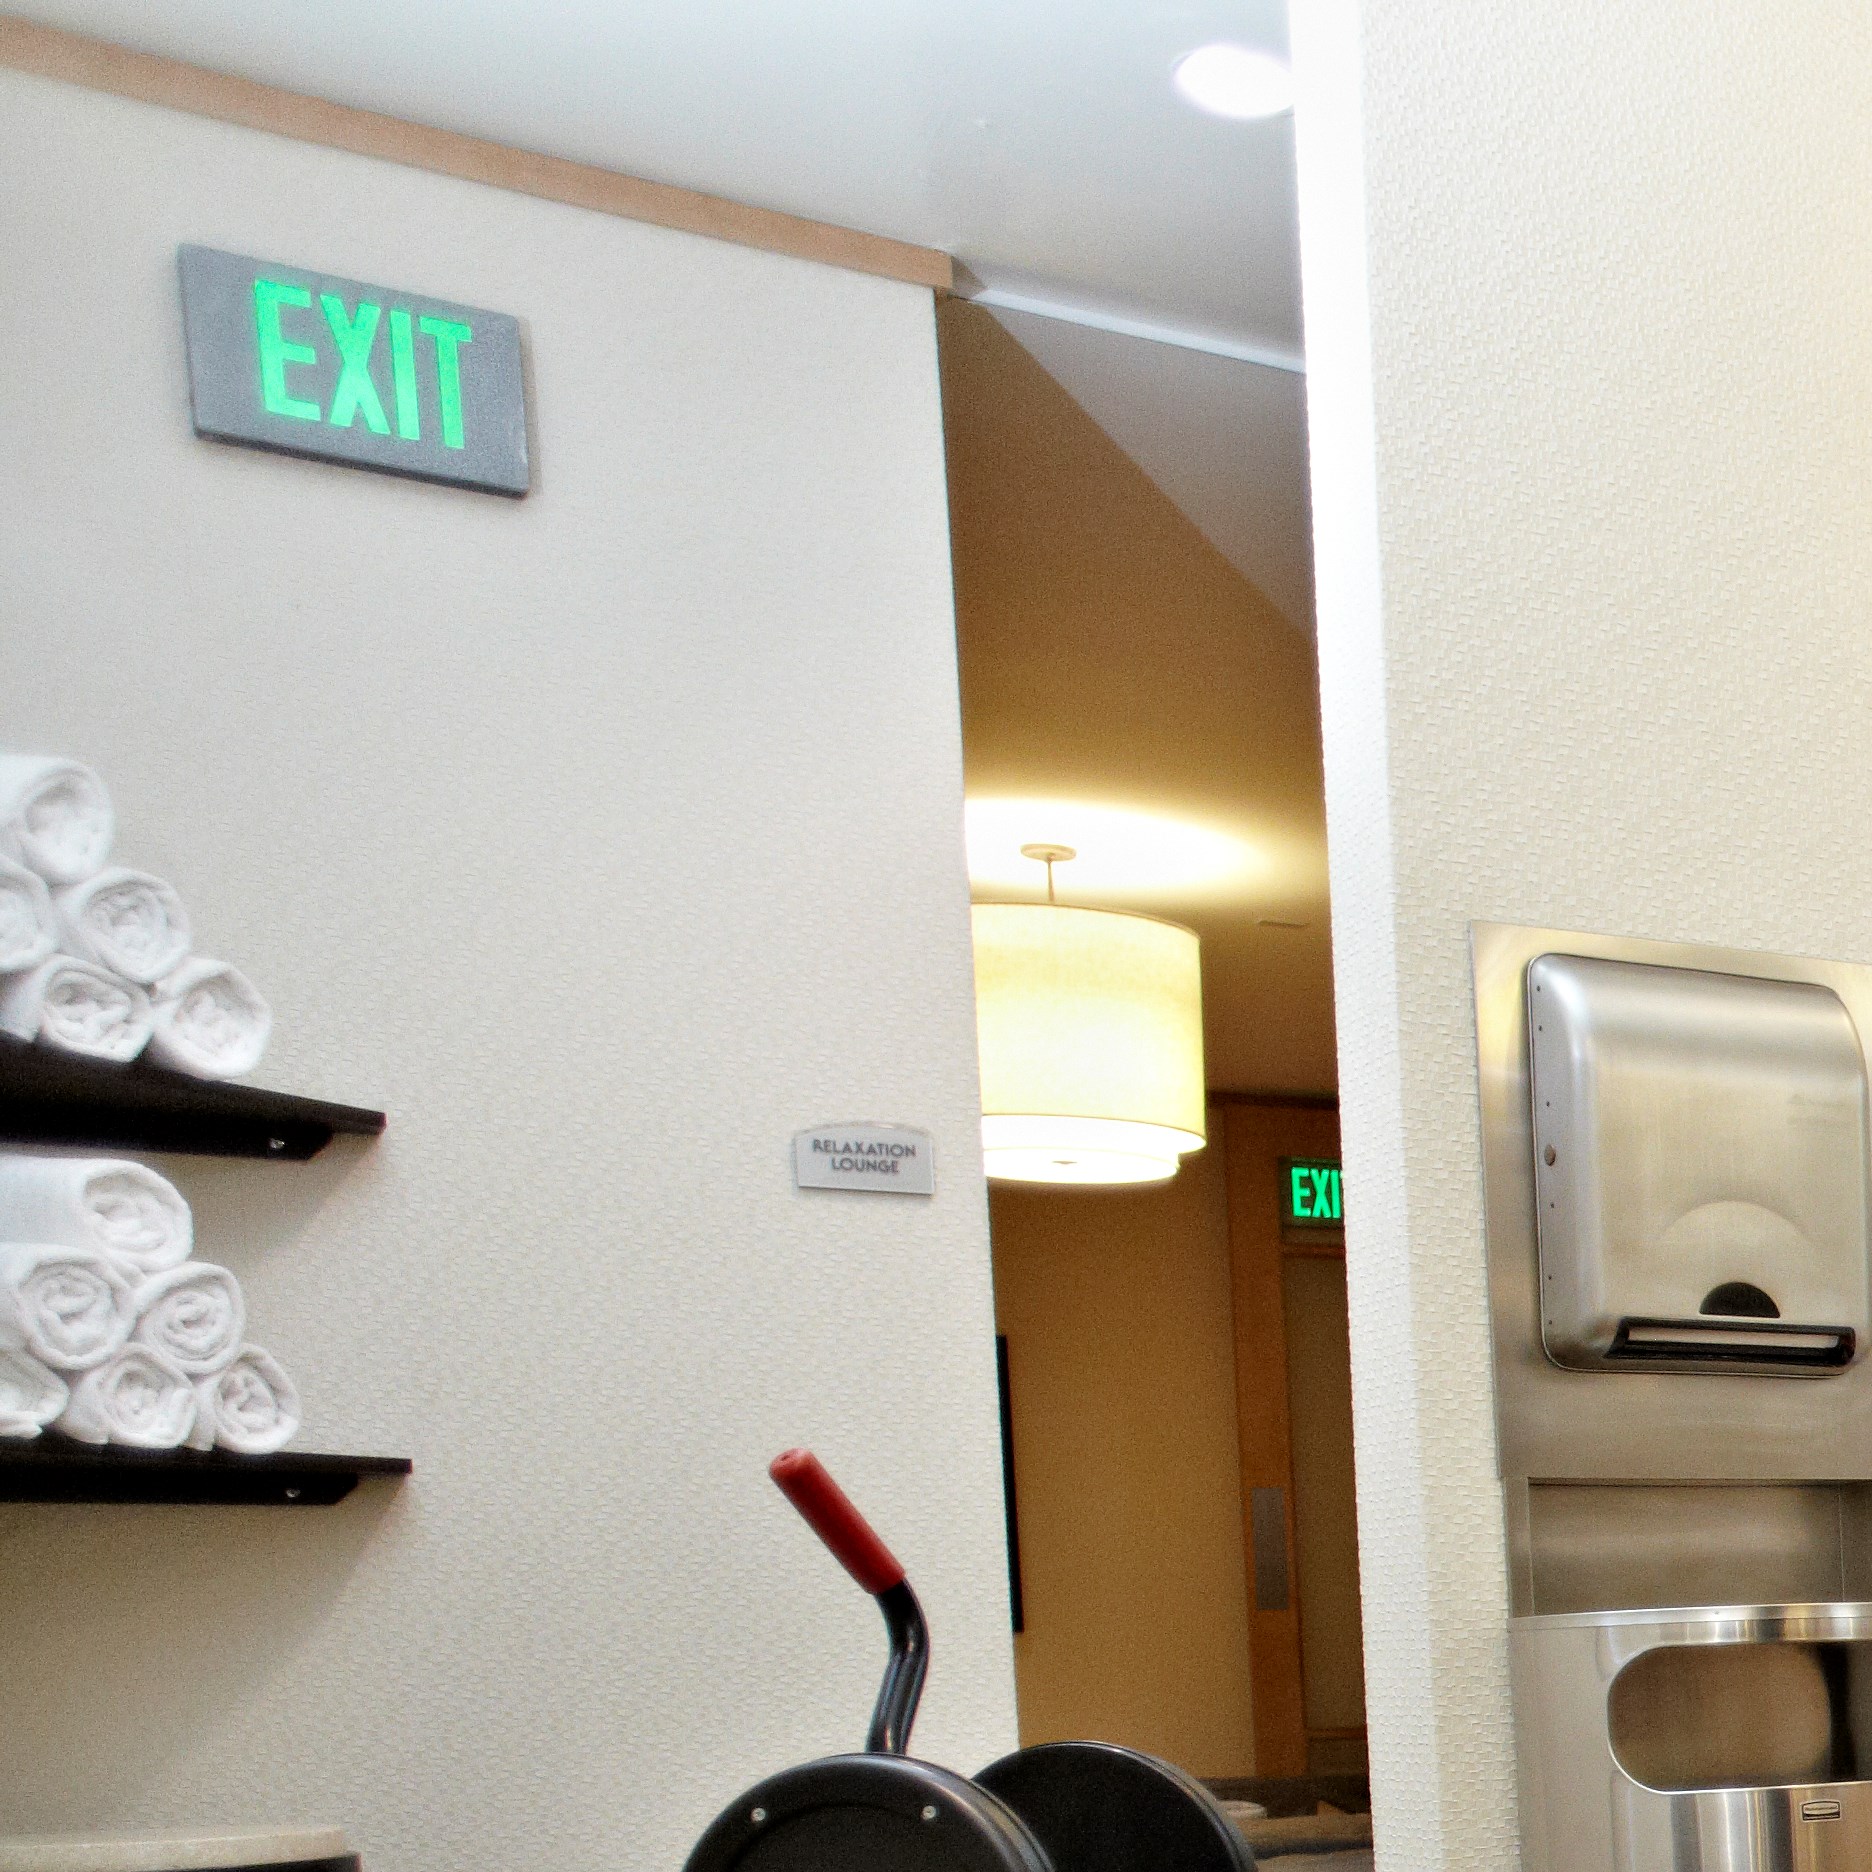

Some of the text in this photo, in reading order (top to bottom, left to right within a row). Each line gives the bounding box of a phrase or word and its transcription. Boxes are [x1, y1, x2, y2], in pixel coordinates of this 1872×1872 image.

[253, 278, 473, 450] EXIT
[812, 1139, 917, 1159] RELAXATION
[831, 1157, 899, 1173] LOUNGE
[1291, 1166, 1343, 1218] EXI
